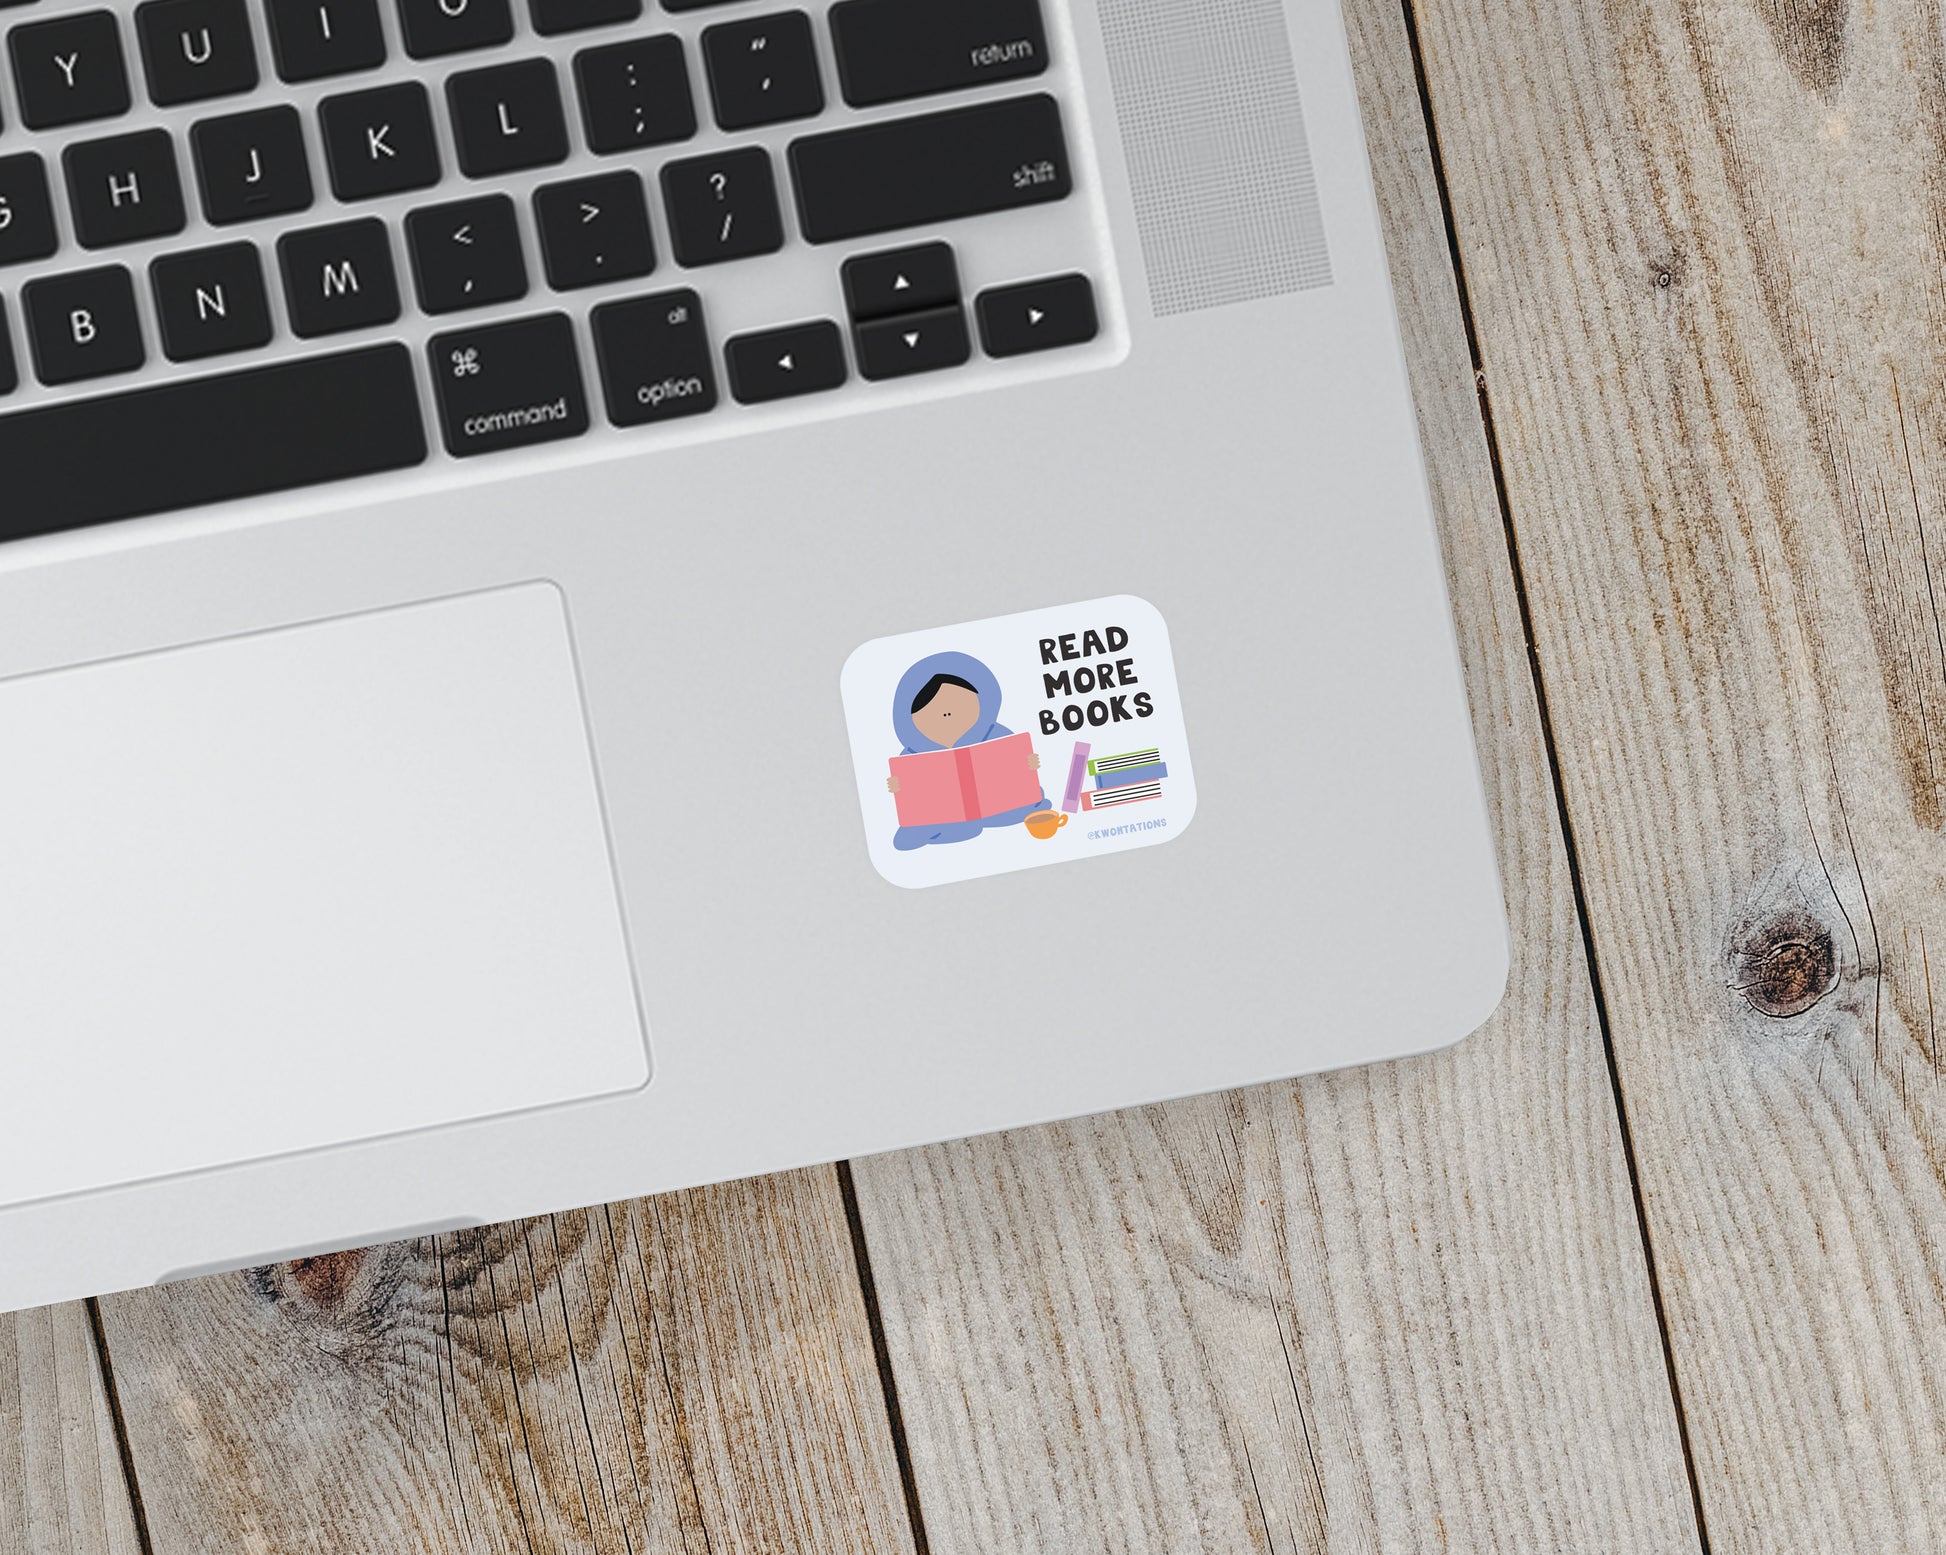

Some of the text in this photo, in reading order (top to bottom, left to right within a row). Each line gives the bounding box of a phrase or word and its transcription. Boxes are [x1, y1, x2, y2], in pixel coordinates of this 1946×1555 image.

[319, 6, 331, 39] I
[181, 28, 212, 64] U
[970, 40, 1033, 66] return
[54, 52, 78, 87] Y
[498, 103, 519, 135] L
[367, 124, 395, 160] K
[246, 149, 261, 183] J
[1012, 160, 1055, 188] shift
[109, 172, 140, 207] H
[709, 173, 726, 199] ?
[323, 261, 359, 297] M
[195, 284, 226, 320] N
[70, 309, 96, 343] B
[637, 377, 703, 406] option
[464, 397, 567, 435] command
[1039, 626, 1129, 665] READ
[1042, 658, 1139, 699] MORE
[1038, 692, 1154, 735] BOOKS
